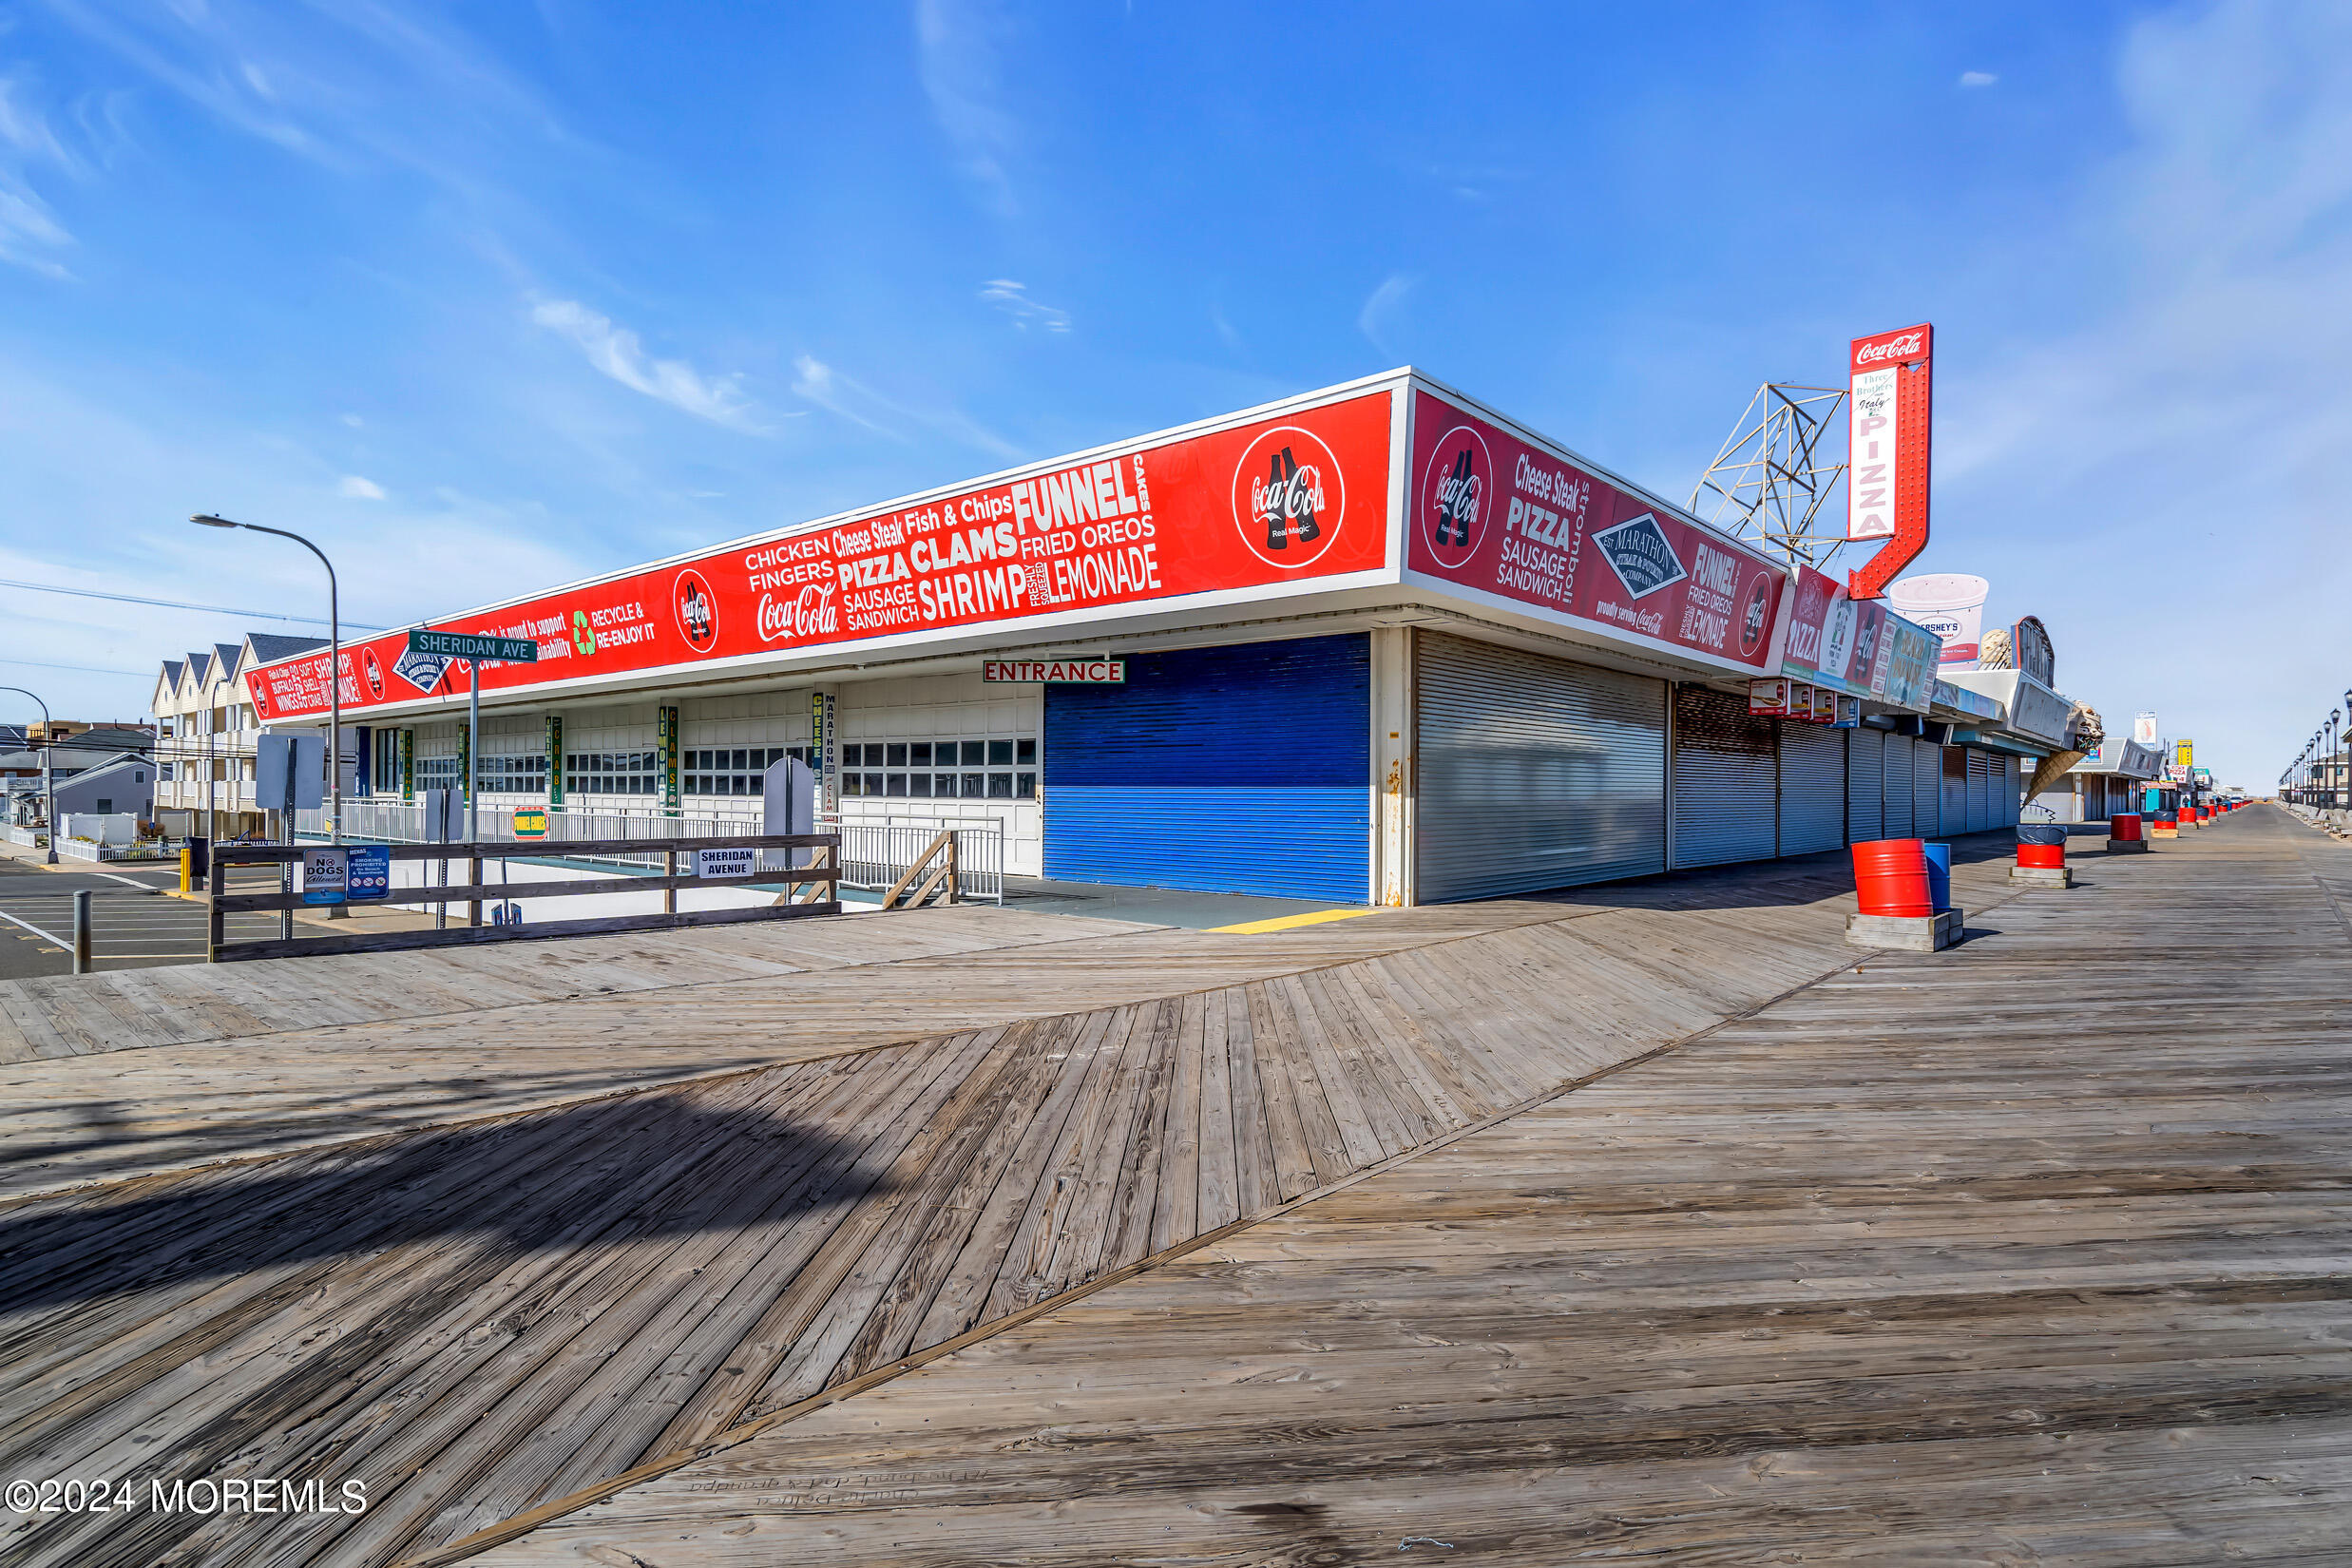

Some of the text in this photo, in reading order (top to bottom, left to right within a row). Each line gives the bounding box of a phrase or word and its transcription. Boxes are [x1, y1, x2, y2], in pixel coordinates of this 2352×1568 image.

[1856, 332, 1923, 364] Coca-Cola
[1857, 384, 1892, 395] Brothers
[1864, 374, 1887, 384] Three
[1860, 397, 1886, 410] Italy
[1133, 454, 1151, 512] CAKES
[1252, 465, 1325, 523] Coca-Cola
[1434, 464, 1482, 523] Coca-Cola
[1515, 453, 1579, 513] Cheese Steak
[1856, 415, 1888, 534] PIZZA
[905, 494, 1013, 535] Fish & Chips
[1011, 459, 1138, 535] FUNNEL
[832, 516, 905, 558] Cheese Steak
[1021, 515, 1156, 560] FRIED OREOS
[1272, 525, 1310, 537] Real Magic
[1506, 496, 1569, 552] PIZZA
[745, 537, 830, 570] CHICKEN
[910, 523, 1018, 573] CLAMS
[1501, 536, 1567, 580] SAUSAGE
[1616, 529, 1673, 570] MARATHON
[749, 560, 834, 592] FINGERS
[838, 552, 911, 590] PIZZA
[1024, 564, 1041, 606] FRESHLY
[1035, 562, 1049, 605] SQUEEZED
[1044, 544, 1161, 603] LEMONADE
[1496, 563, 1563, 602] SANDWICH
[1692, 543, 1735, 597] FUNNEL
[757, 581, 838, 642] Coca-Cola
[844, 583, 916, 613] SAUSAGE
[919, 564, 1026, 621] SHRIMP
[1687, 584, 1733, 616] FRIED OREOS
[499, 612, 566, 639] is proud to support
[591, 602, 644, 627] RECYCLE &
[847, 604, 920, 631] SANDWICH
[1597, 601, 1618, 621] proudly
[1617, 606, 1636, 626] serving
[1688, 608, 1729, 649] LEMONADE
[1920, 623, 1958, 632] ERSHEY'S
[419, 635, 495, 656] SHERIDAN
[502, 641, 528, 659] AVE
[596, 622, 656, 649] RE-ENJOY IT
[1787, 619, 1821, 663] PIZZA
[314, 654, 350, 679] SHRMP
[985, 662, 1120, 681] ENTRANCE
[276, 692, 299, 712] WINGS
[813, 696, 822, 757] CHEESE
[826, 696, 835, 763] MARATHON
[668, 711, 677, 784] CLAMS
[701, 851, 753, 861] SHERIDAN
[708, 864, 747, 874] AVENUE
